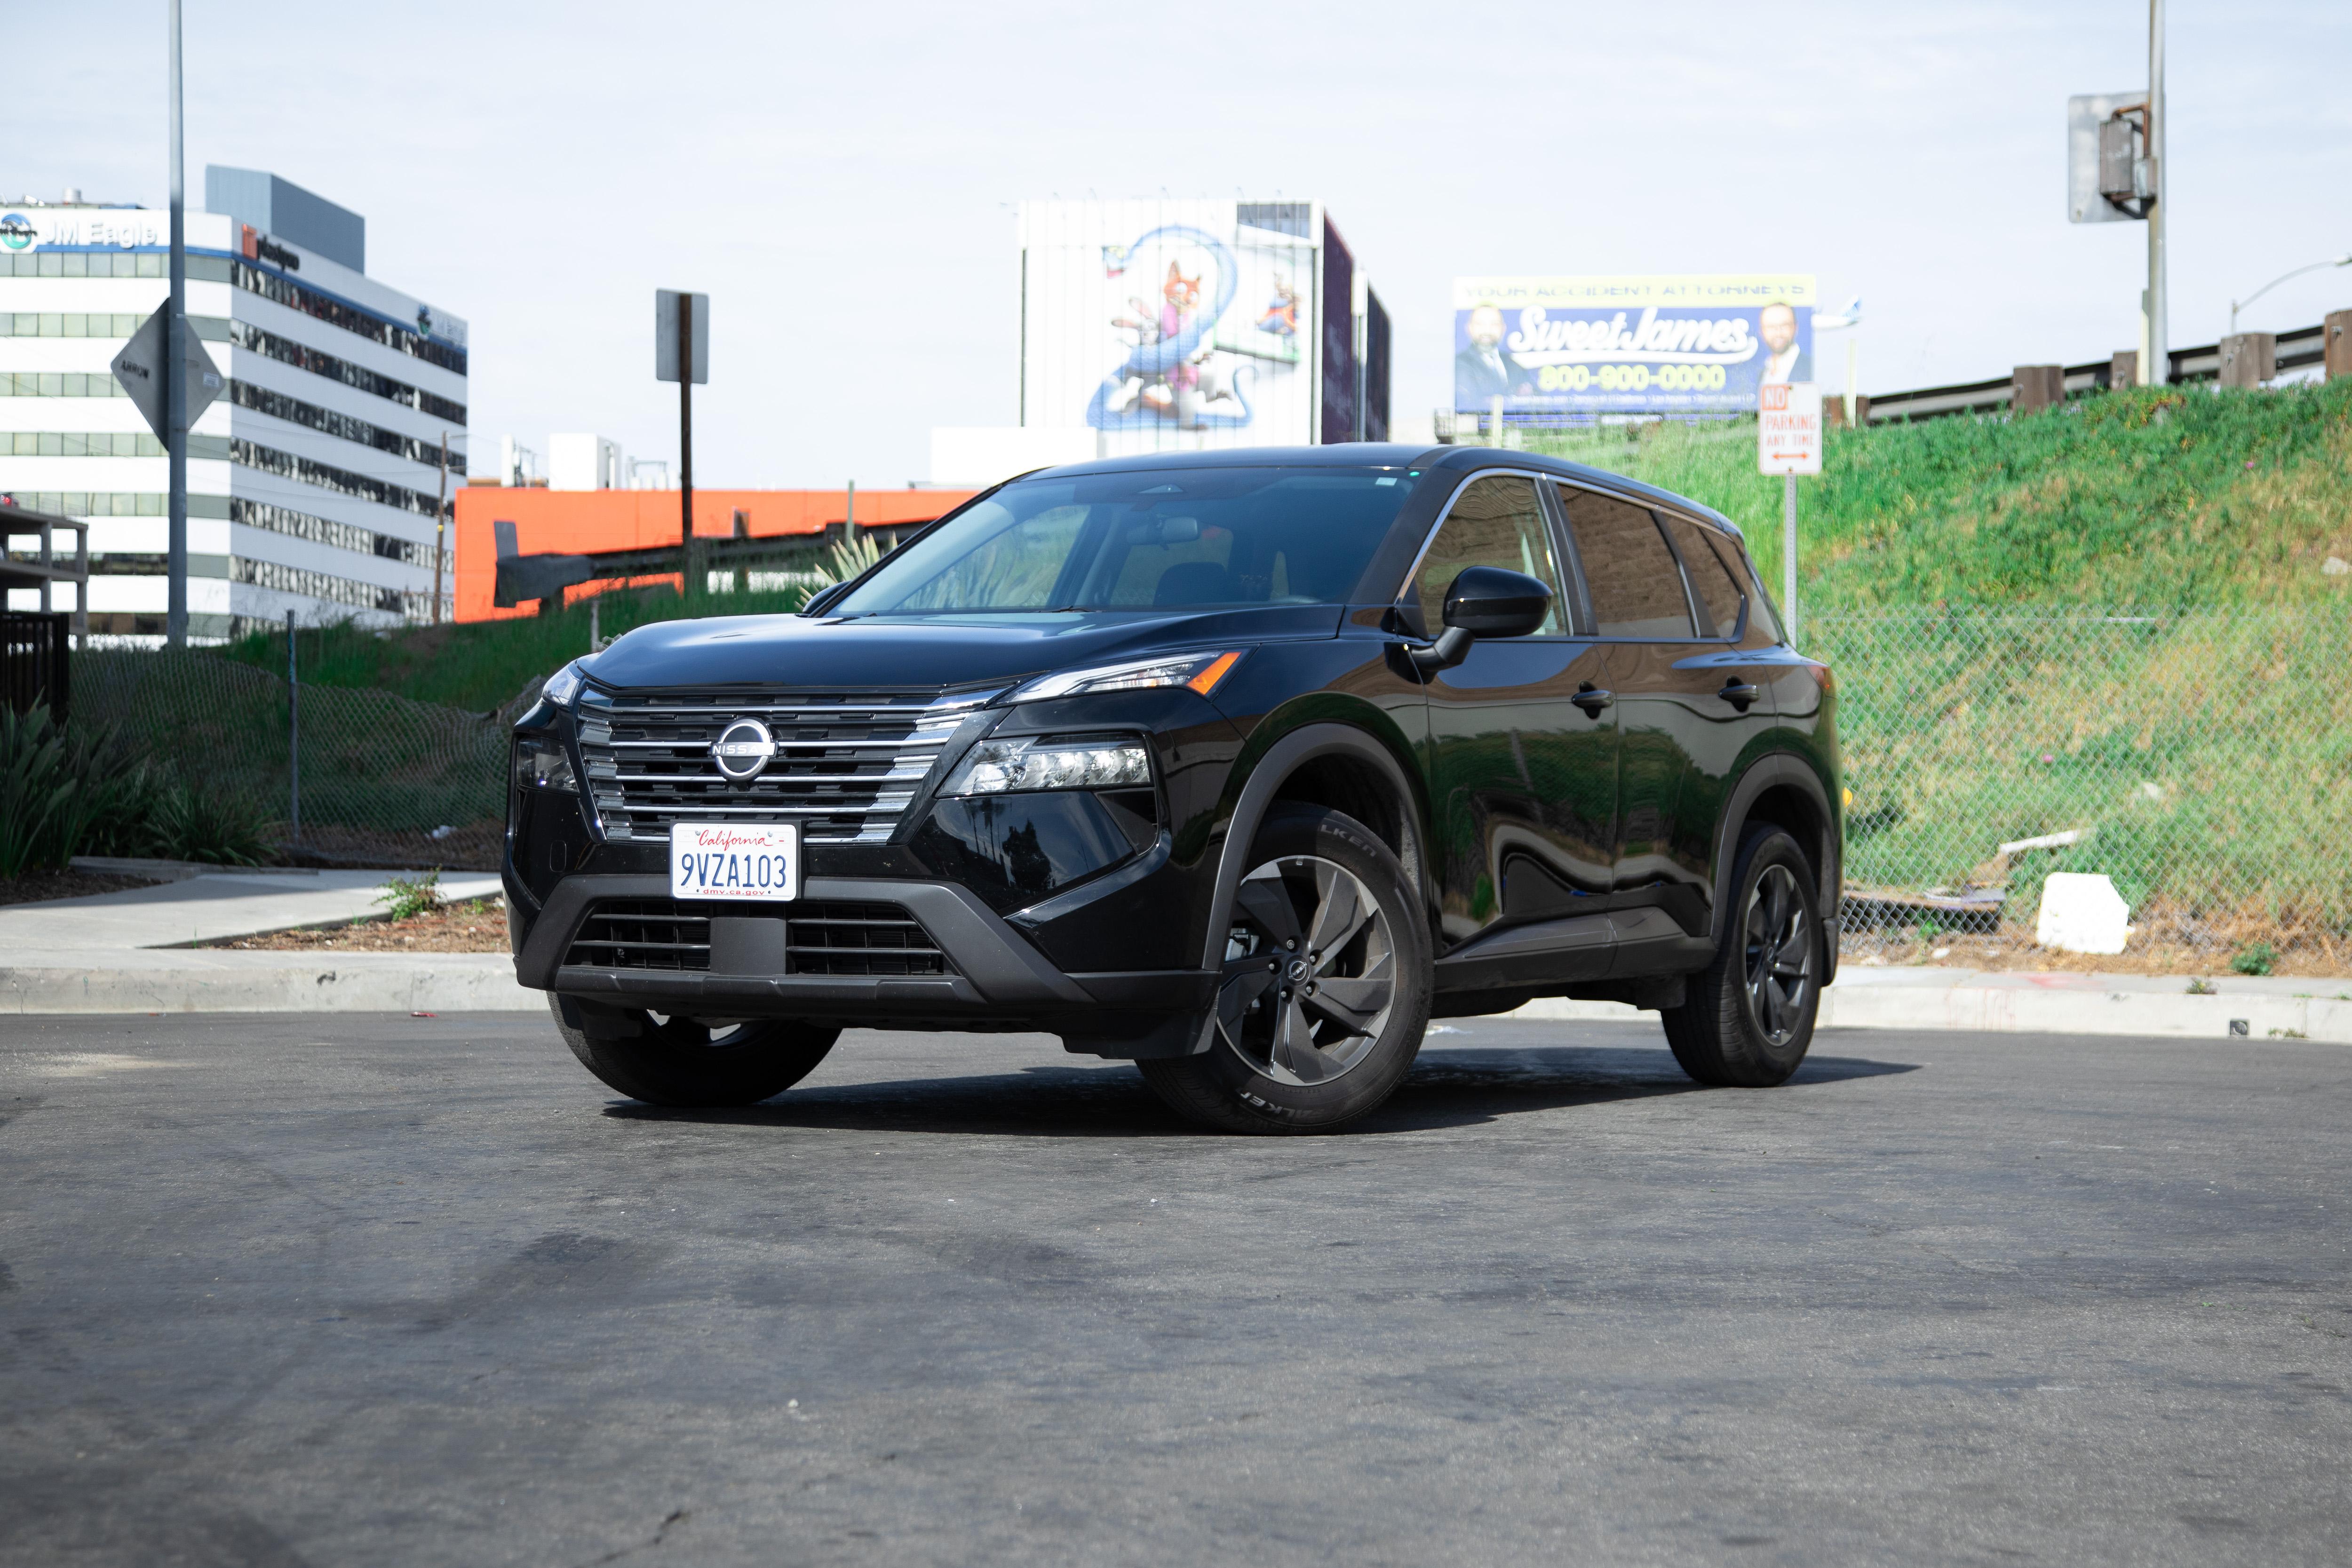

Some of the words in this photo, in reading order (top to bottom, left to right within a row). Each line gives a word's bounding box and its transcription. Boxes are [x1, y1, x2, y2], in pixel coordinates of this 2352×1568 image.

[45, 220, 79, 245] JM
[90, 219, 158, 249] Eagle
[1464, 286, 1527, 296] YOUR
[1536, 285, 1651, 296] ACCIDENT
[1663, 285, 1804, 295] ATTORNEYS
[120, 359, 150, 379] ARROW
[1538, 364, 1726, 391] 800-900-0000
[1765, 387, 1786, 408] NO
[1766, 414, 1817, 430] PARKING
[1767, 434, 1786, 446] ANY
[1792, 433, 1815, 446] TIME
[712, 744, 774, 755] NISSA
[699, 829, 774, 852] California
[1318, 824, 1377, 857] LKEN
[681, 853, 787, 888] 9VZA103
[1288, 962, 1308, 979] NISSAN
